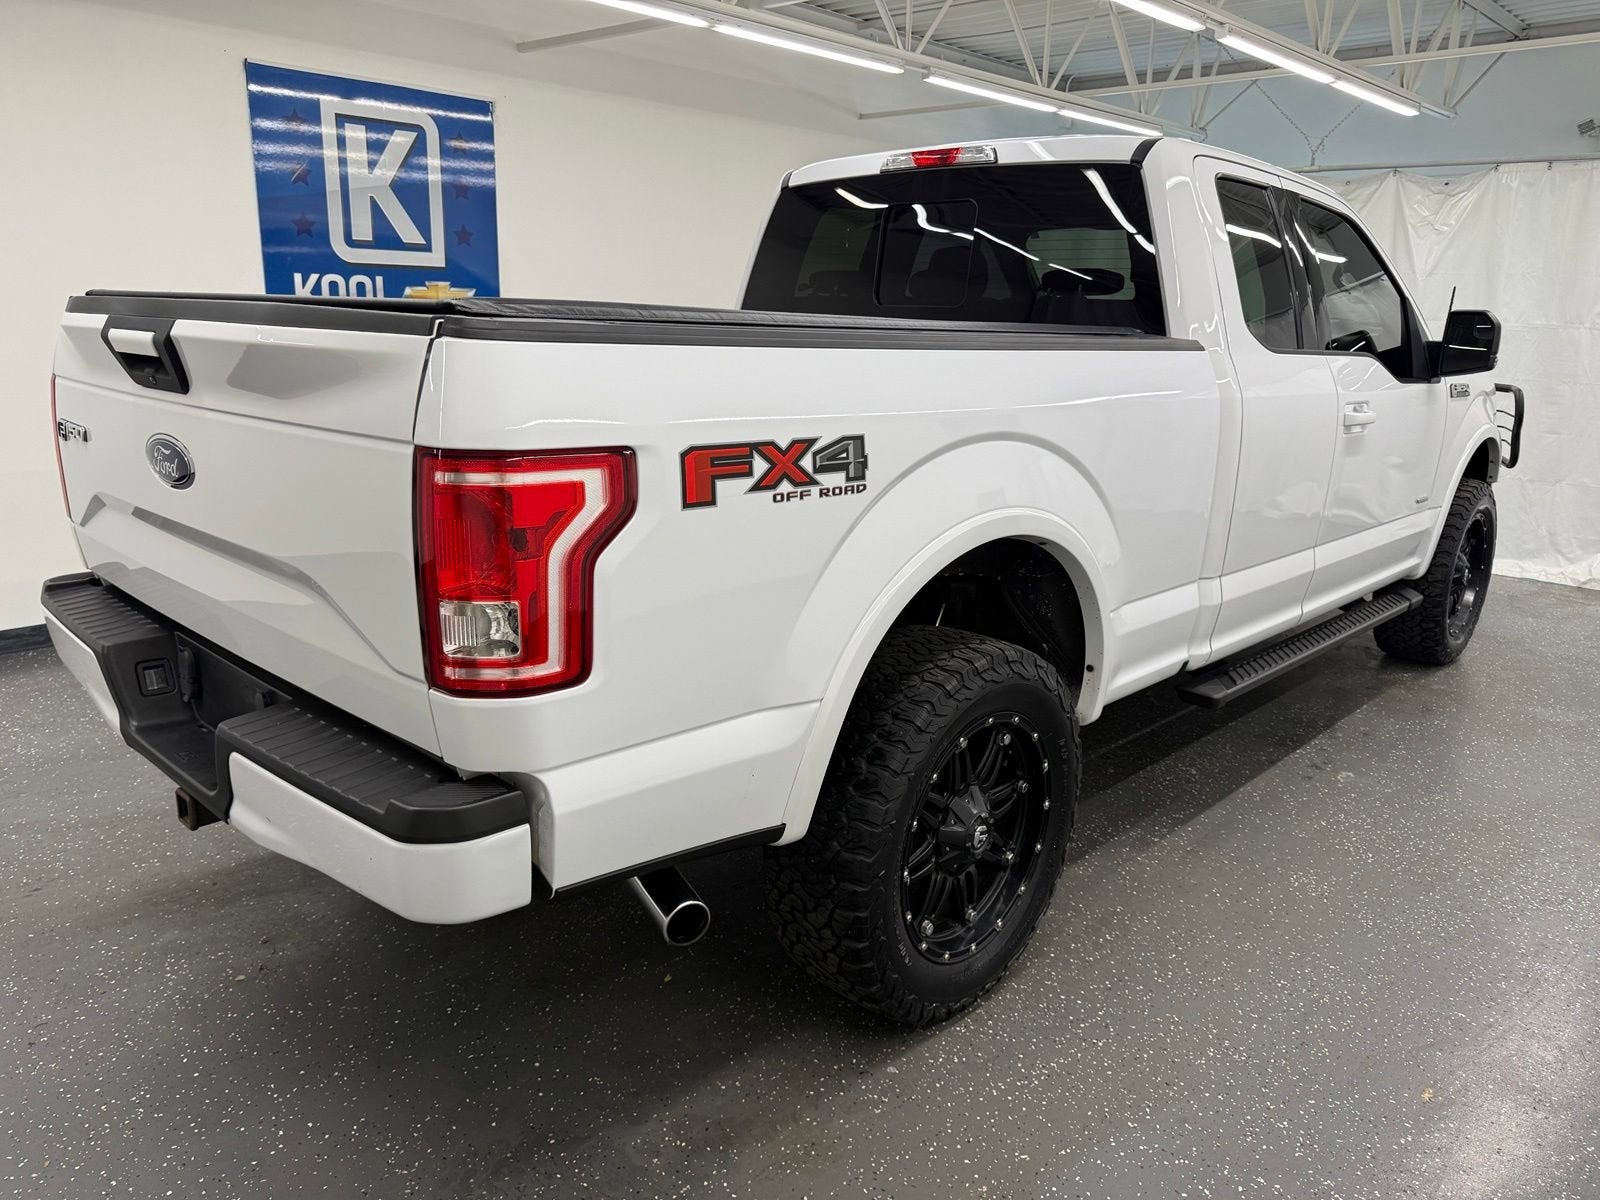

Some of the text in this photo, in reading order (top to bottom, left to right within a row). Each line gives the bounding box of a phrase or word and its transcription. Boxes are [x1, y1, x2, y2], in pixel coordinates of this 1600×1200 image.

[345, 123, 426, 244] K
[153, 445, 179, 478] Ford
[680, 434, 868, 510] FX4
[772, 484, 867, 503] OFF ROAD
